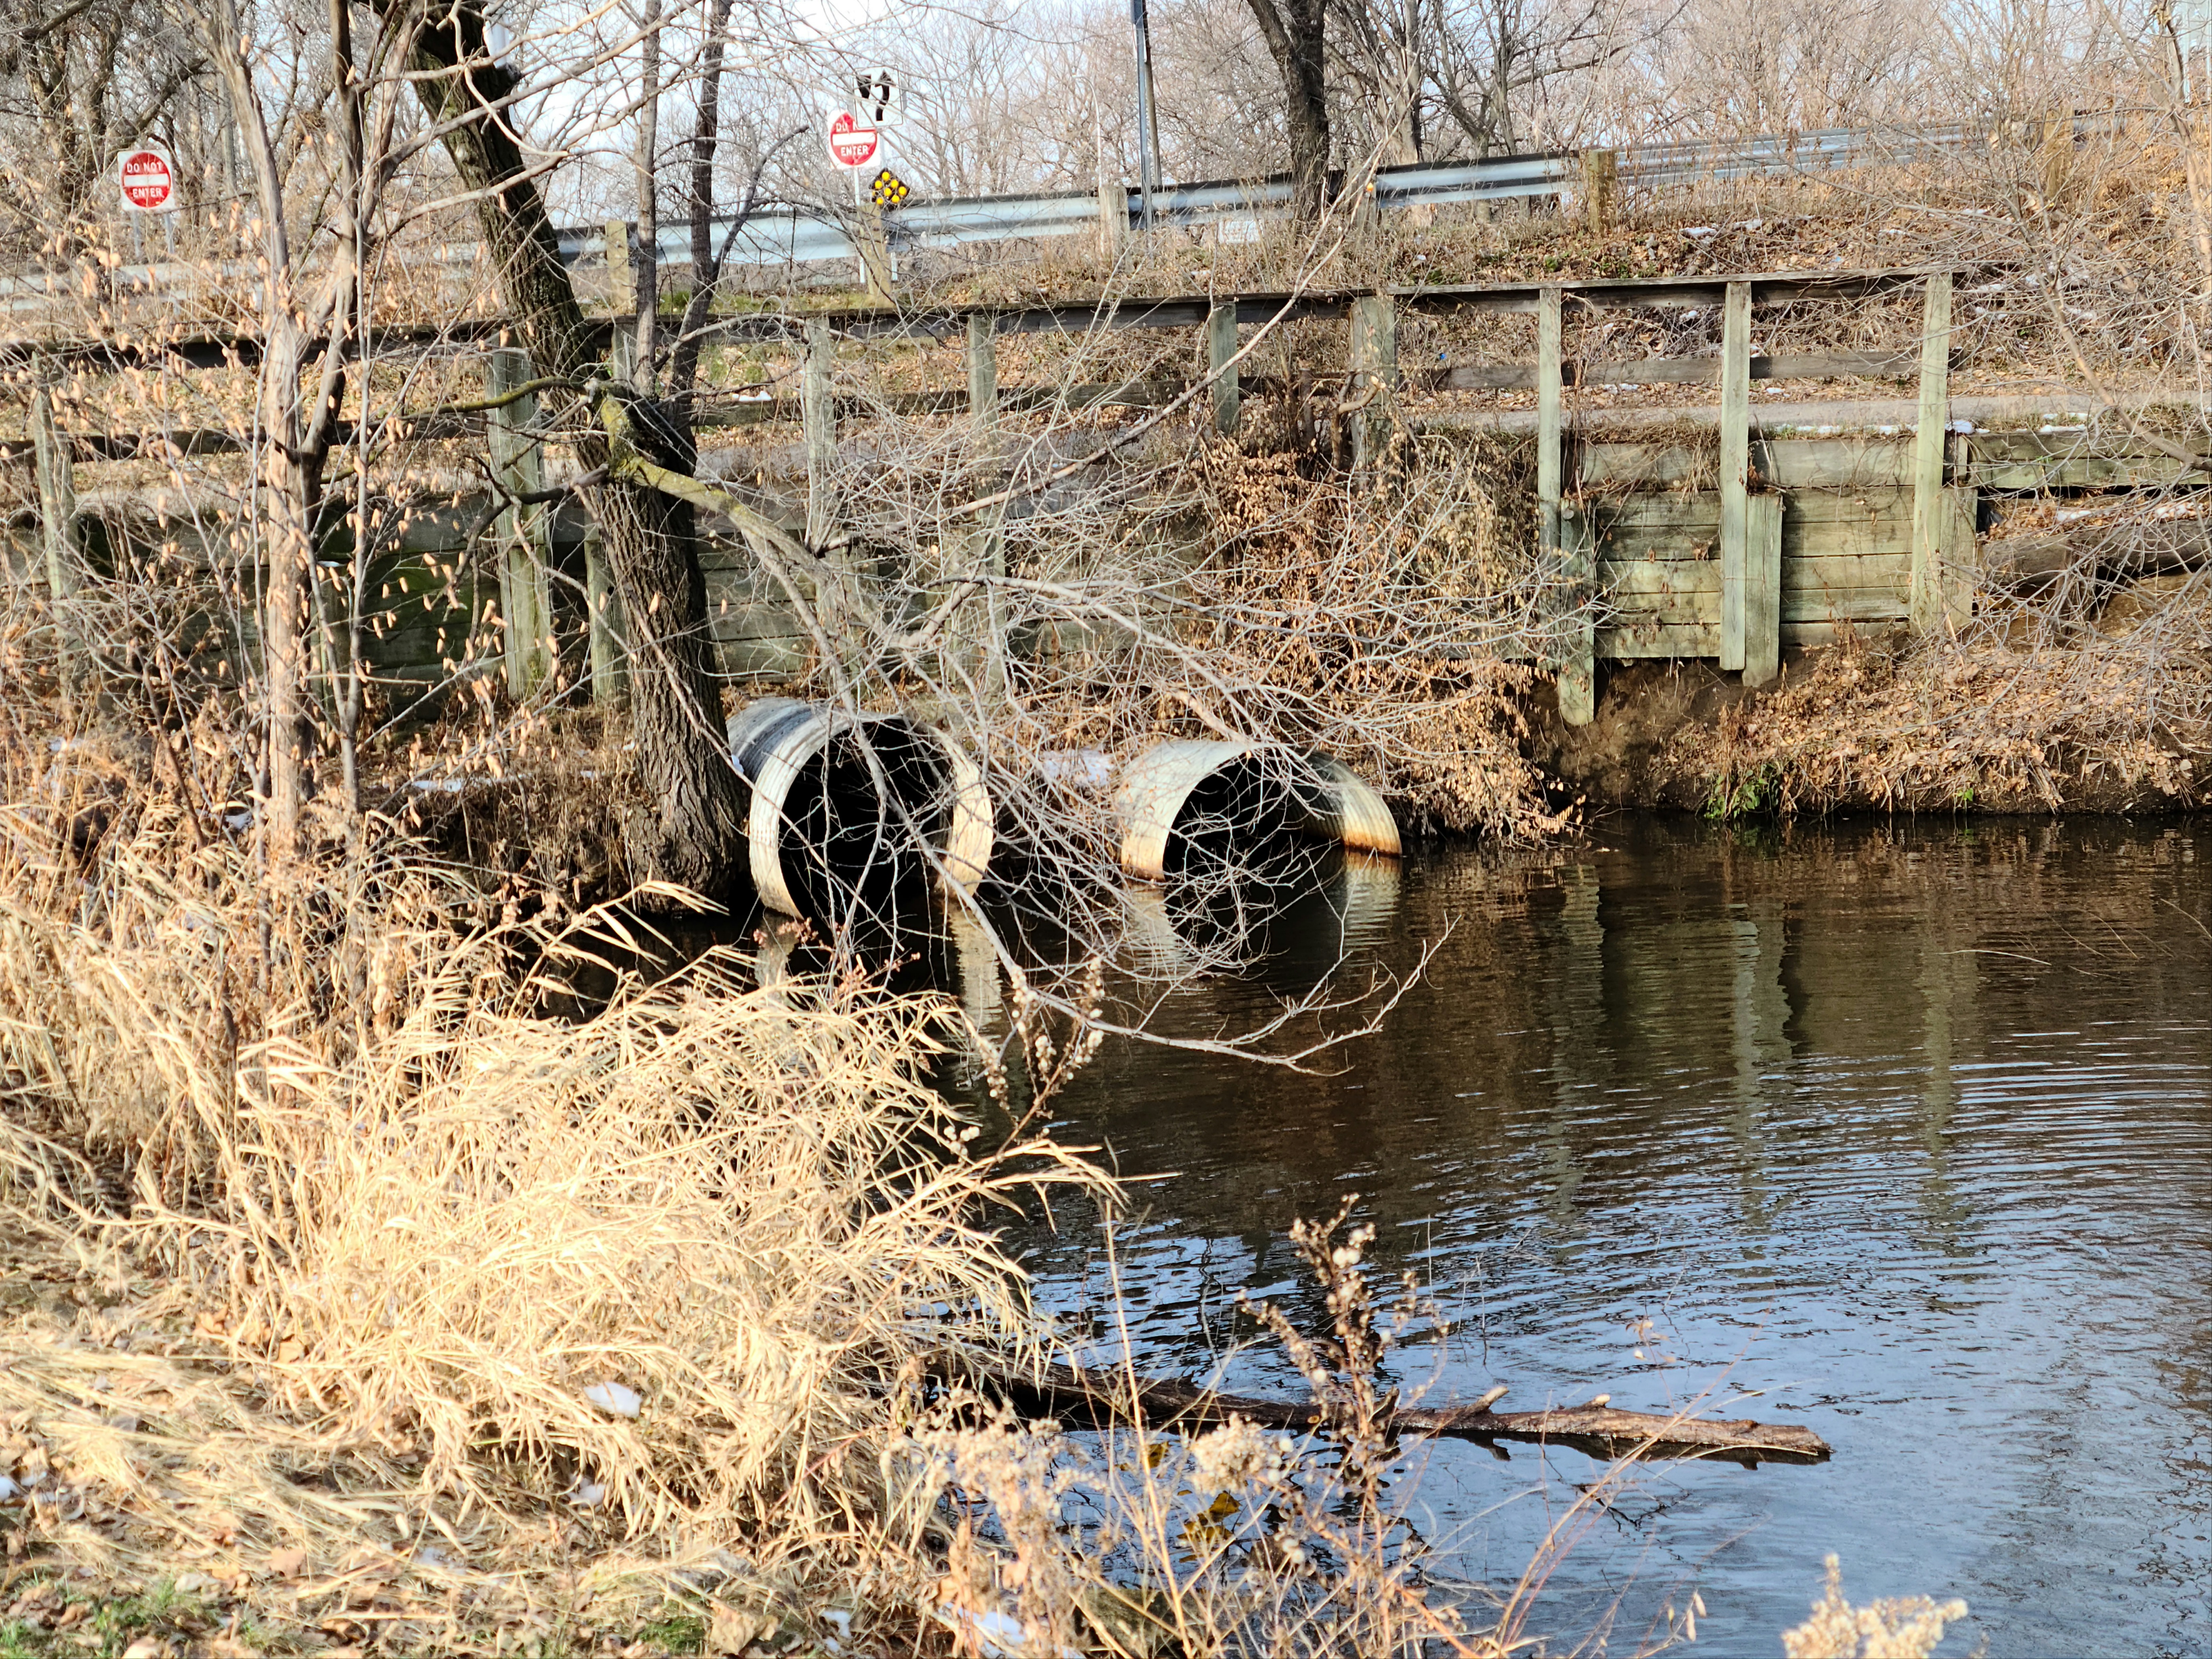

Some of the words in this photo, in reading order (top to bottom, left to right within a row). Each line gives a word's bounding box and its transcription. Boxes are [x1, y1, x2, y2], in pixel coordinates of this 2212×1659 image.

[836, 122, 848, 132] DO
[840, 145, 868, 156] ENTER
[127, 163, 139, 172] DO
[144, 160, 162, 172] NOT
[132, 187, 162, 198] ENTER
